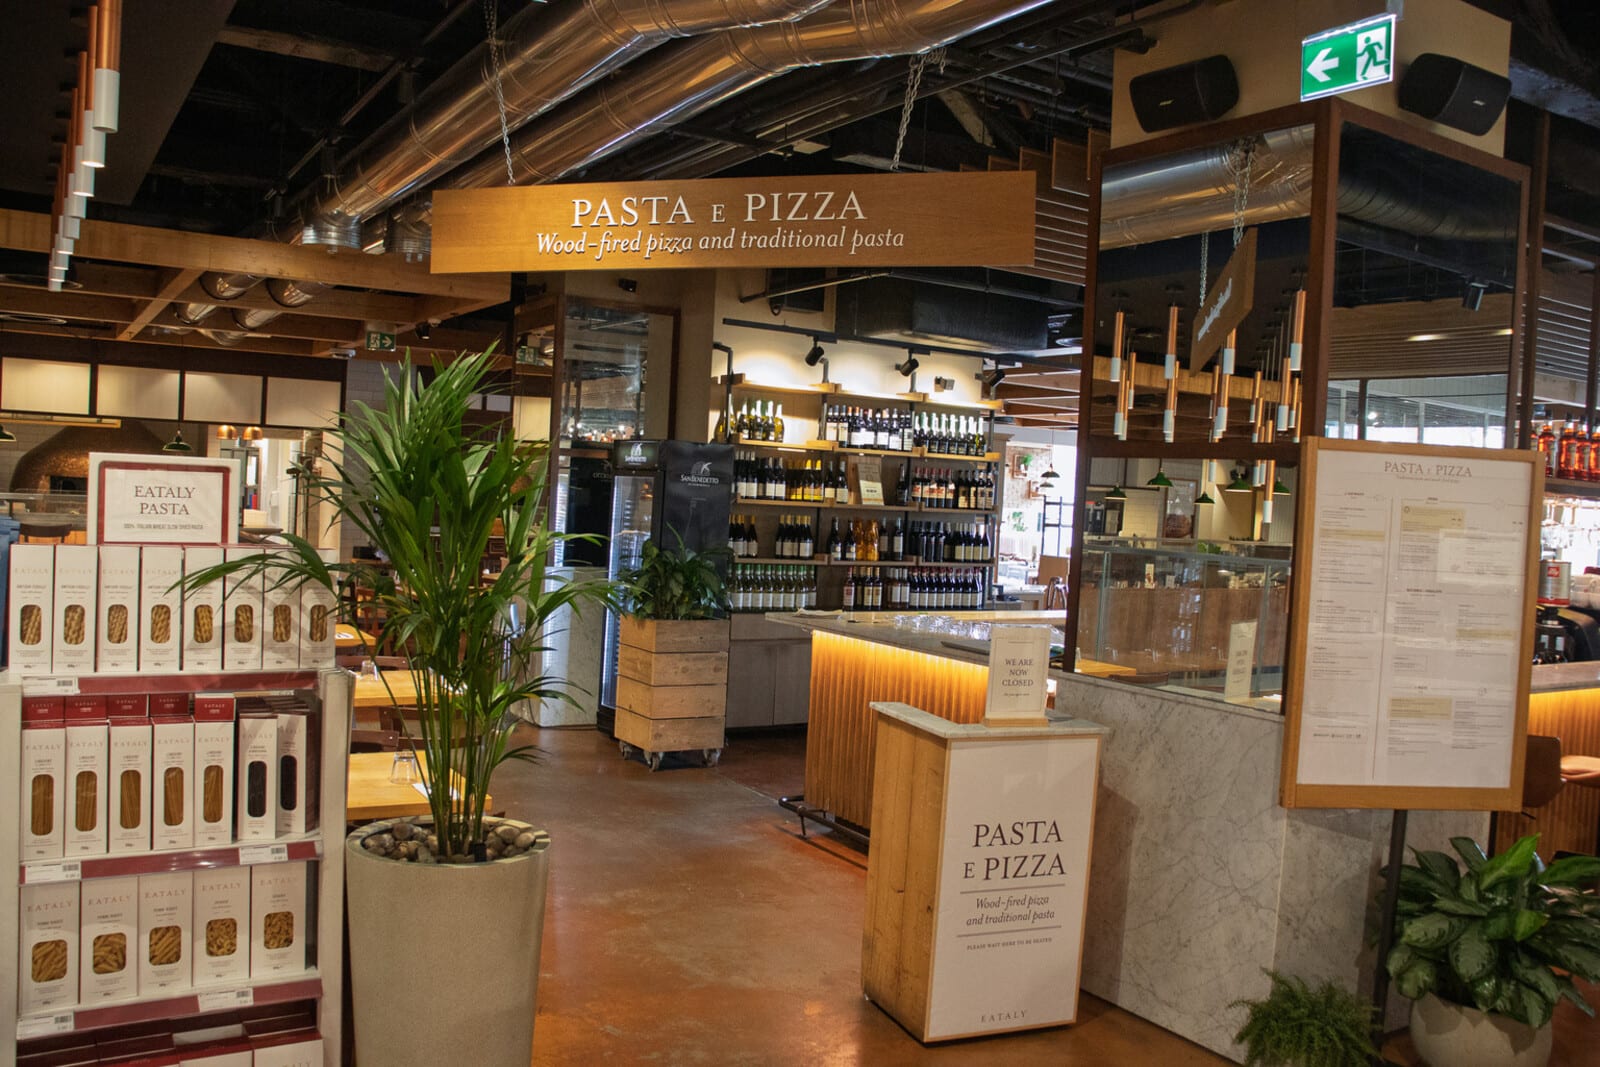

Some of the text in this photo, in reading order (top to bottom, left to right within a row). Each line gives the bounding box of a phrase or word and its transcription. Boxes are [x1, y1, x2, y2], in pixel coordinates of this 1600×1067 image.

[571, 190, 868, 227] PASTA E PIZZA
[536, 226, 905, 260] Wood-fired pizza and traditional pasta
[1384, 461, 1424, 475] PASTA
[1435, 464, 1473, 478] PIZZA
[134, 485, 196, 498] EATALY
[140, 502, 190, 516] PASTA
[1005, 658, 1017, 666] WE
[1002, 679, 1034, 687] CLOSED
[972, 820, 1064, 848] PASTA
[963, 852, 1067, 881] E PIZZA
[202, 882, 241, 892] EATALY
[260, 876, 299, 887] EATALY
[88, 895, 132, 906] EATALY
[145, 888, 186, 899] EATALY
[27, 901, 74, 913] EATALY
[976, 893, 1050, 911] Wood-fired pizza
[966, 909, 1055, 926] and traditional pasta
[980, 1008, 1028, 1023] EATALY
